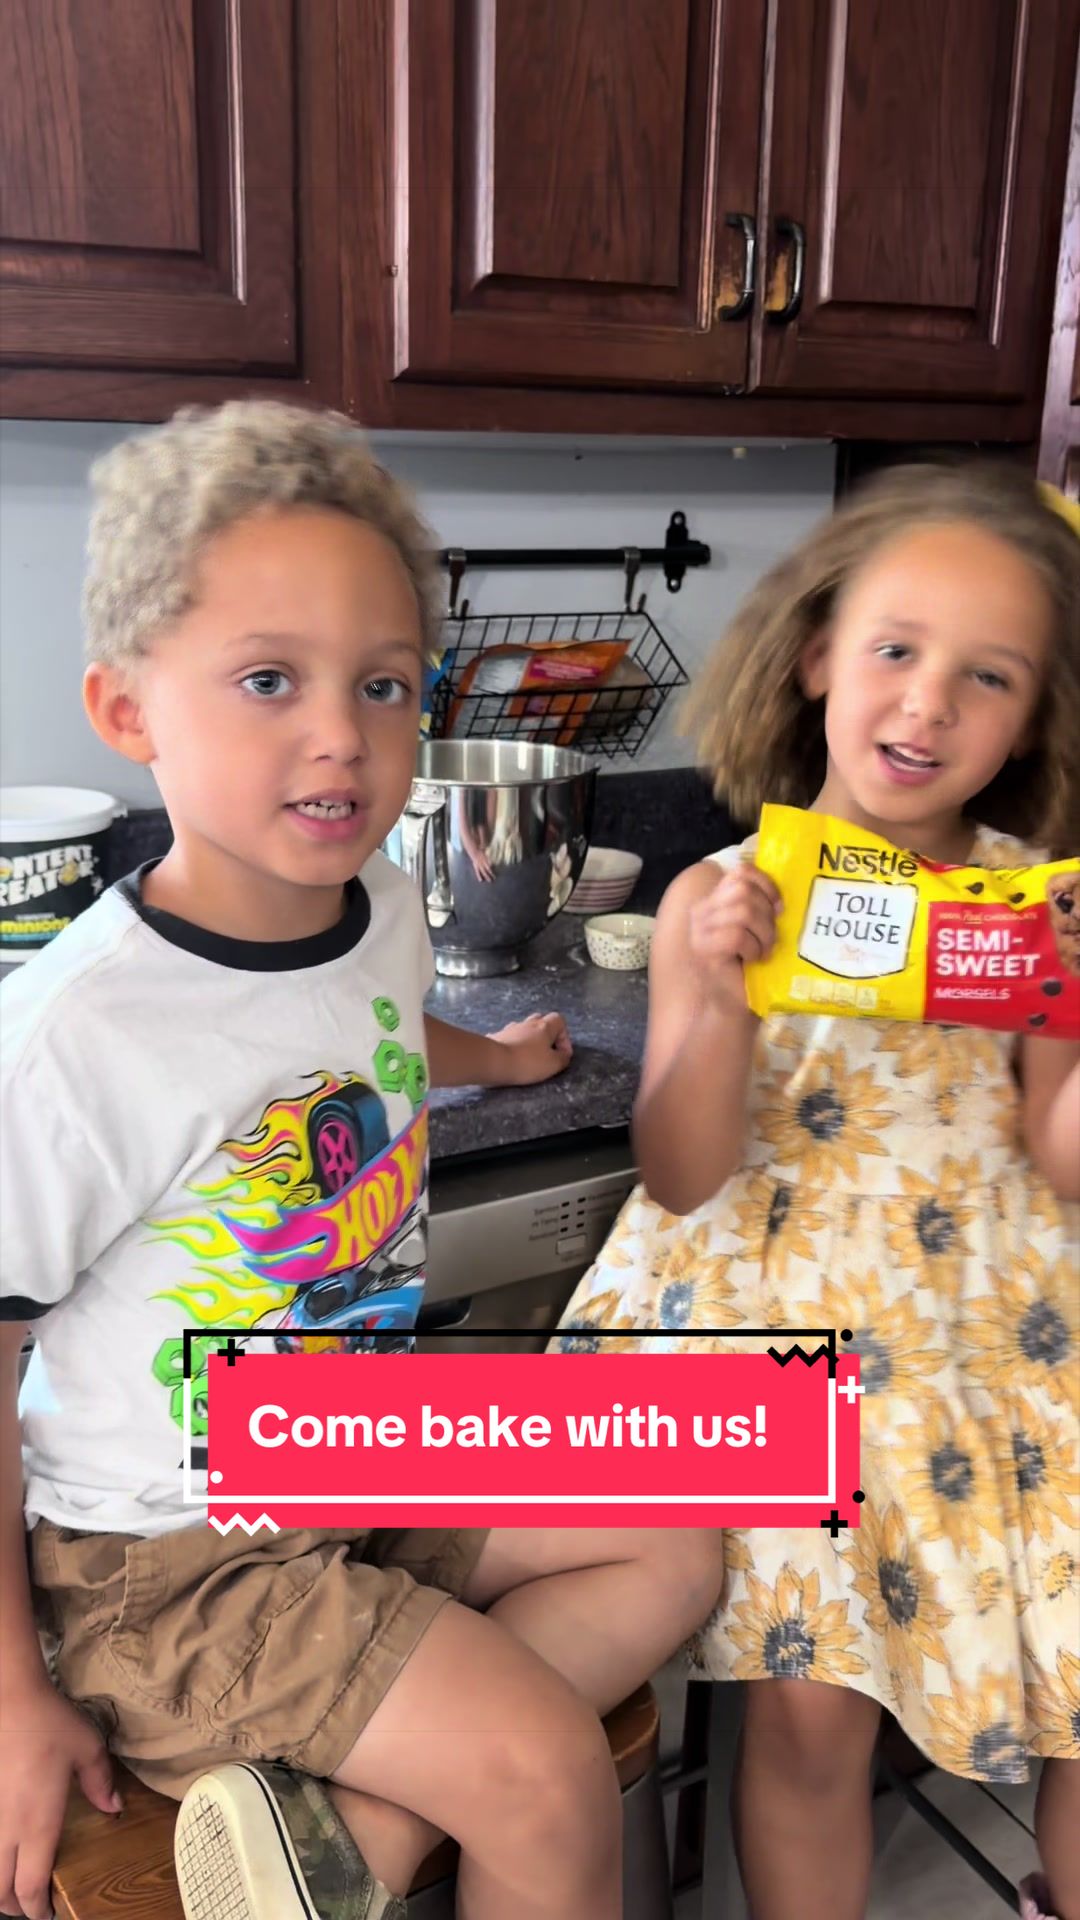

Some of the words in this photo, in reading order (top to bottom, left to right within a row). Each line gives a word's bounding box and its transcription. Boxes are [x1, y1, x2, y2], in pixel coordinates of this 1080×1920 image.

[834, 891, 892, 918] TOLL
[813, 916, 901, 945] HOUSE
[937, 927, 1024, 952] SEMI-
[935, 953, 1041, 977] SWEET
